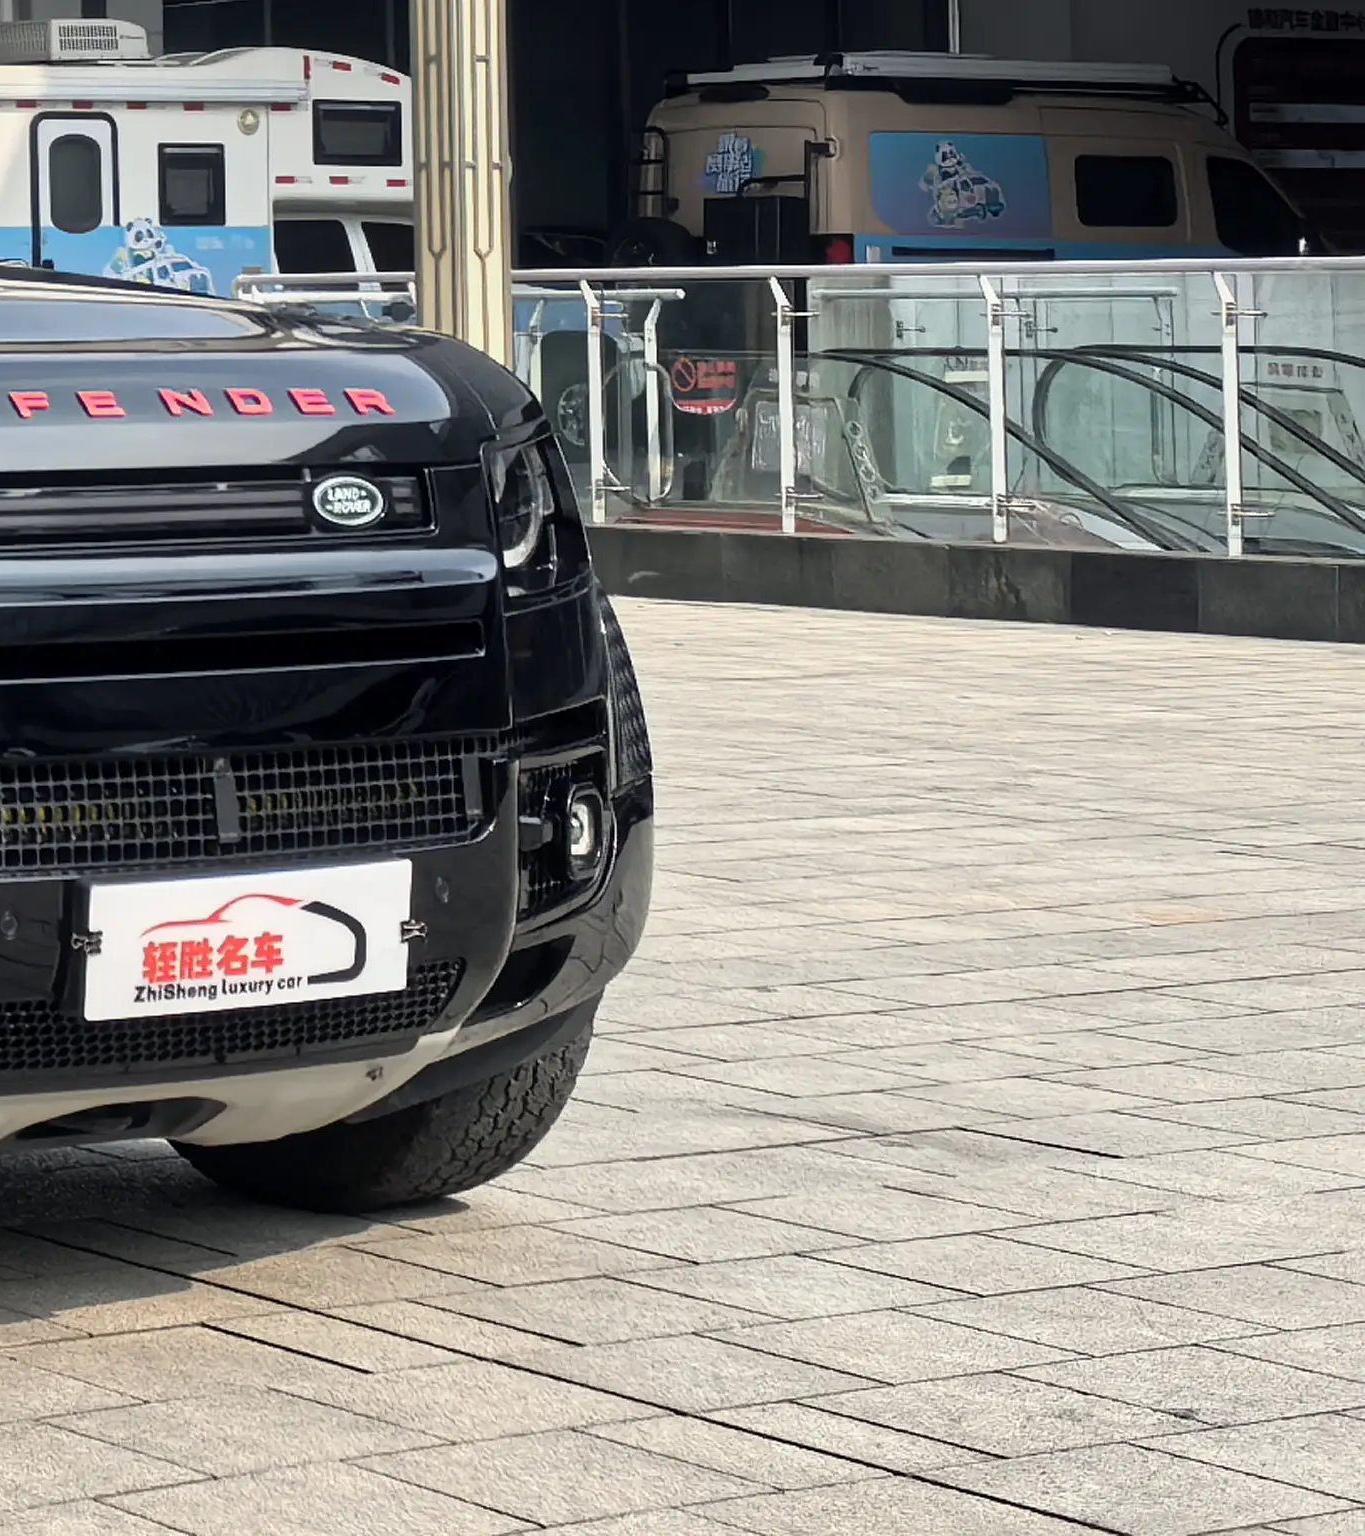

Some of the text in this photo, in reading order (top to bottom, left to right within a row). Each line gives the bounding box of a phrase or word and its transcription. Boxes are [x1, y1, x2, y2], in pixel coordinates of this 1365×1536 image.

[327, 486, 360, 501] LAND
[332, 499, 371, 514] ROVER
[133, 975, 303, 1003] ZhiSheng luxury car
